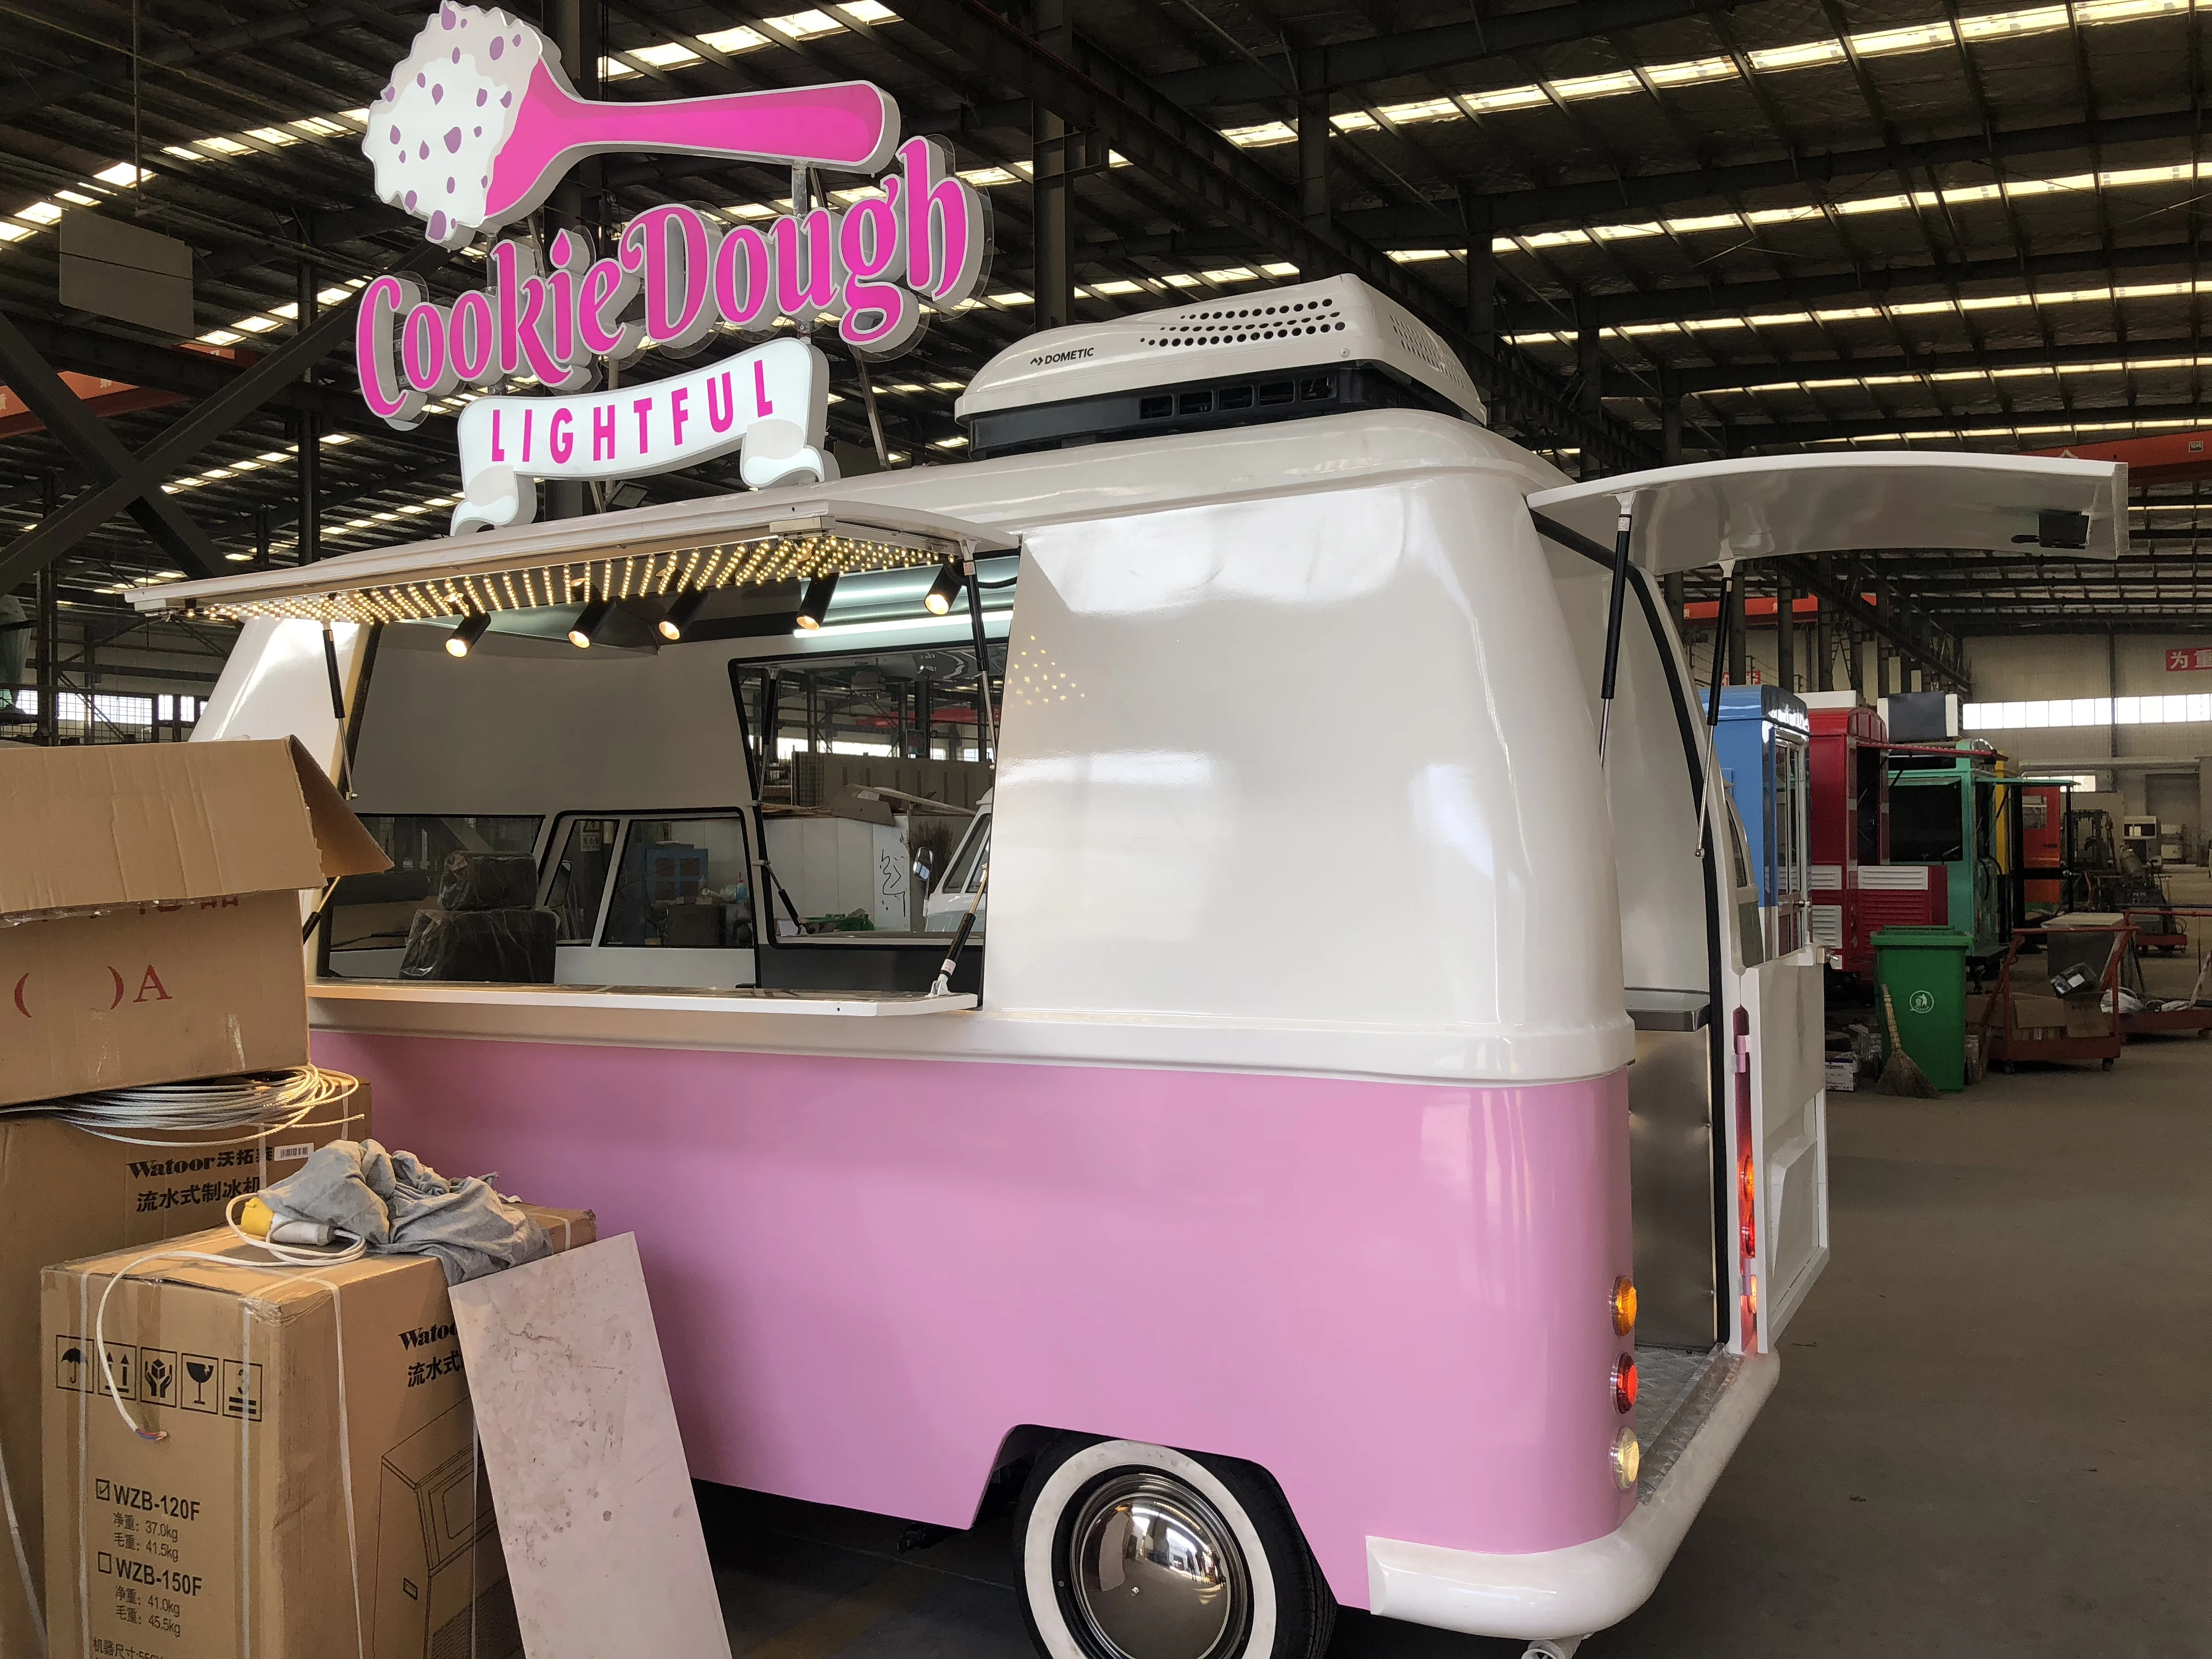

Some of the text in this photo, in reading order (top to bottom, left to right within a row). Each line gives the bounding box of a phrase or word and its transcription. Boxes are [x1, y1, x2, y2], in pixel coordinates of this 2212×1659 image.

[1045, 347, 1094, 365] DOMETIC
[491, 359, 774, 462] LIGHTFUL
[114, 1484, 200, 1521] WZB-120F
[116, 1557, 202, 1596] WZB-150F
